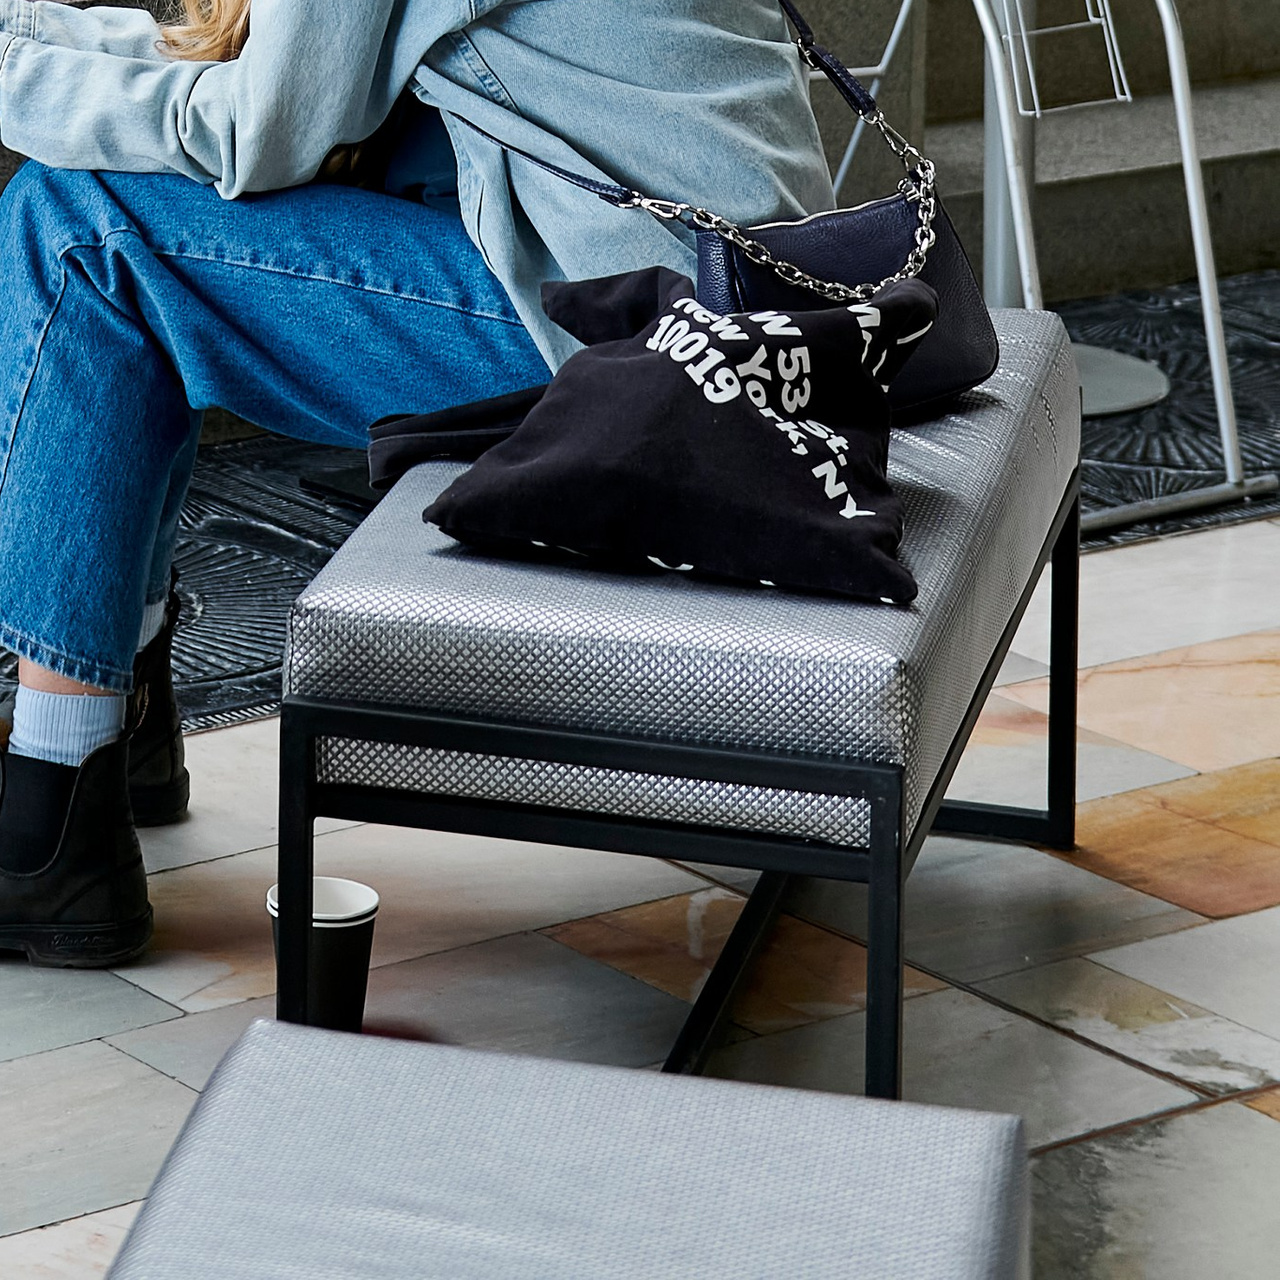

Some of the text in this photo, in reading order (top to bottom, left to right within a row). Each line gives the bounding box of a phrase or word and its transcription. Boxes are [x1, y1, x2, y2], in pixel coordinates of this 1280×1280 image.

[645, 314, 742, 404] 10019
[777, 346, 811, 413] 53
[673, 297, 749, 341] New
[811, 460, 876, 519] NY
